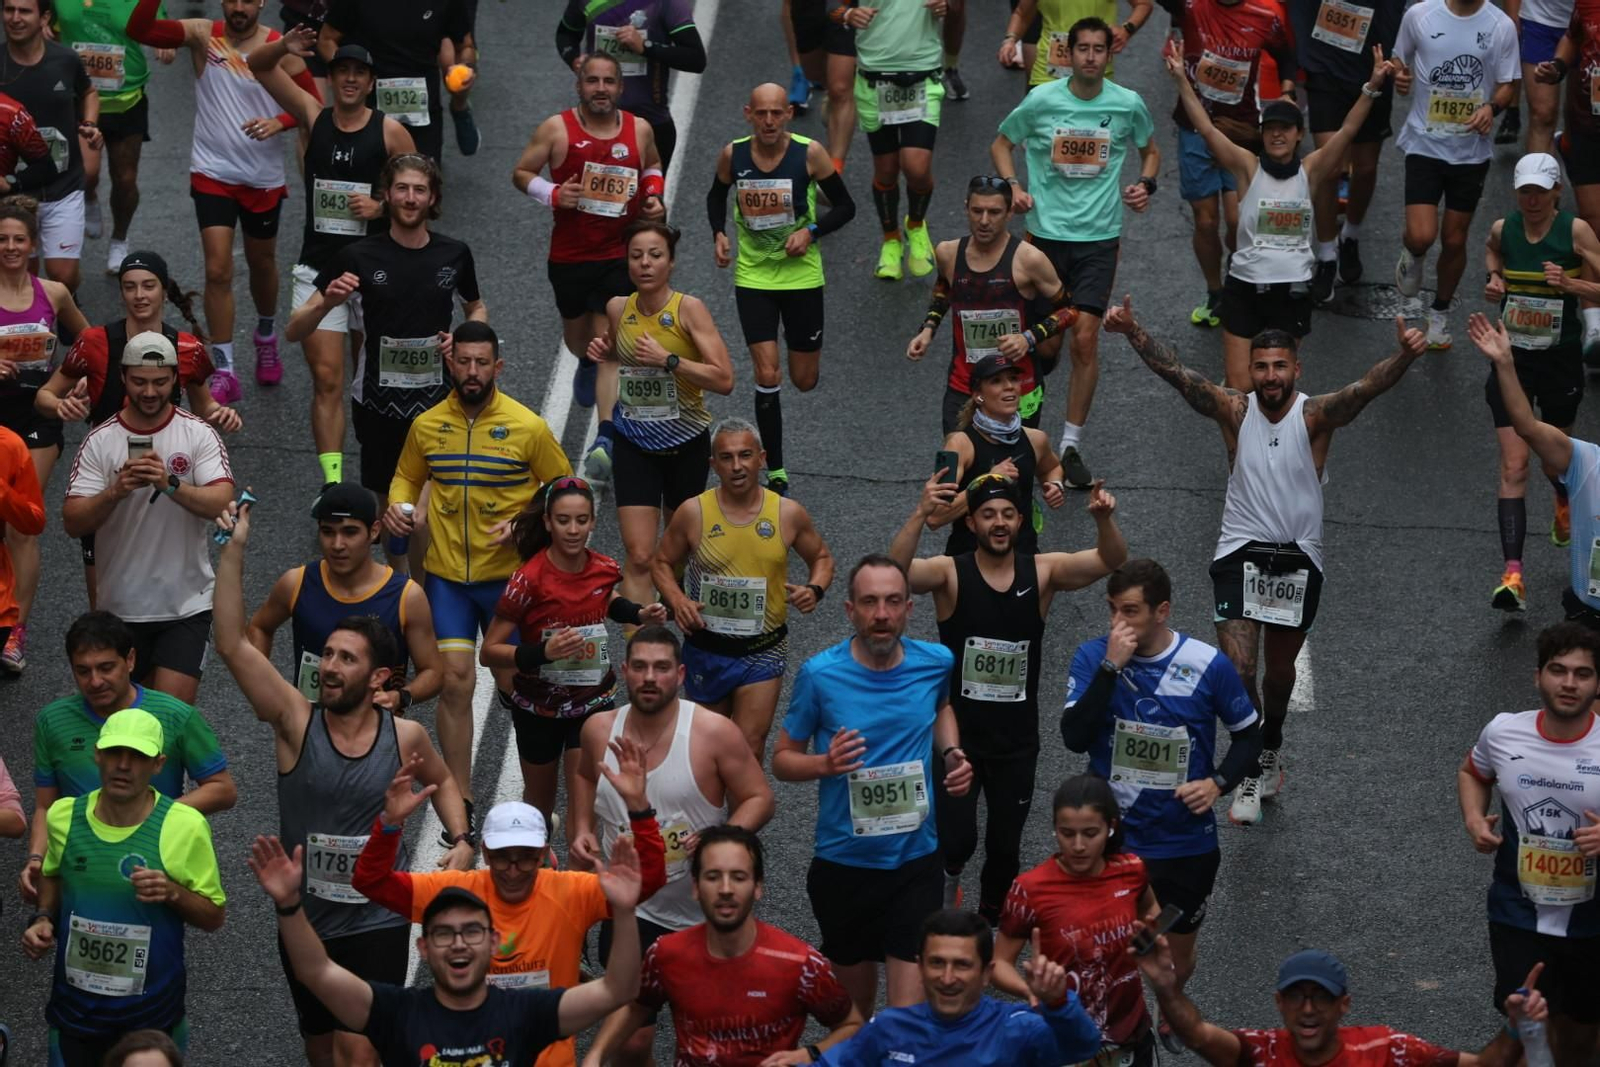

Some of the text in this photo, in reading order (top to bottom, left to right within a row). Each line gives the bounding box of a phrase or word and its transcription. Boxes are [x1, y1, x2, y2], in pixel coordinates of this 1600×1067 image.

[1325, 9, 1357, 31] 6351
[1204, 66, 1238, 86] 4795
[384, 90, 417, 106] 9132
[1433, 98, 1475, 117] 11879
[1061, 140, 1096, 157] 5948
[591, 176, 624, 195] 6163
[745, 192, 779, 208] 6079
[1266, 211, 1303, 228] 7095
[1508, 307, 1553, 329] 10300
[970, 321, 1007, 341] 7740
[390, 349, 430, 367] 7269
[626, 379, 663, 398] 8599
[1248, 575, 1297, 602] 16160
[708, 588, 751, 611] 8613
[973, 652, 1017, 677] 6811
[1123, 736, 1172, 764] 8201
[860, 780, 909, 808] 9951
[1520, 776, 1584, 792] mediolanum
[1539, 808, 1562, 819] 15K
[1525, 851, 1585, 877] 14020
[78, 936, 129, 965] 9562
